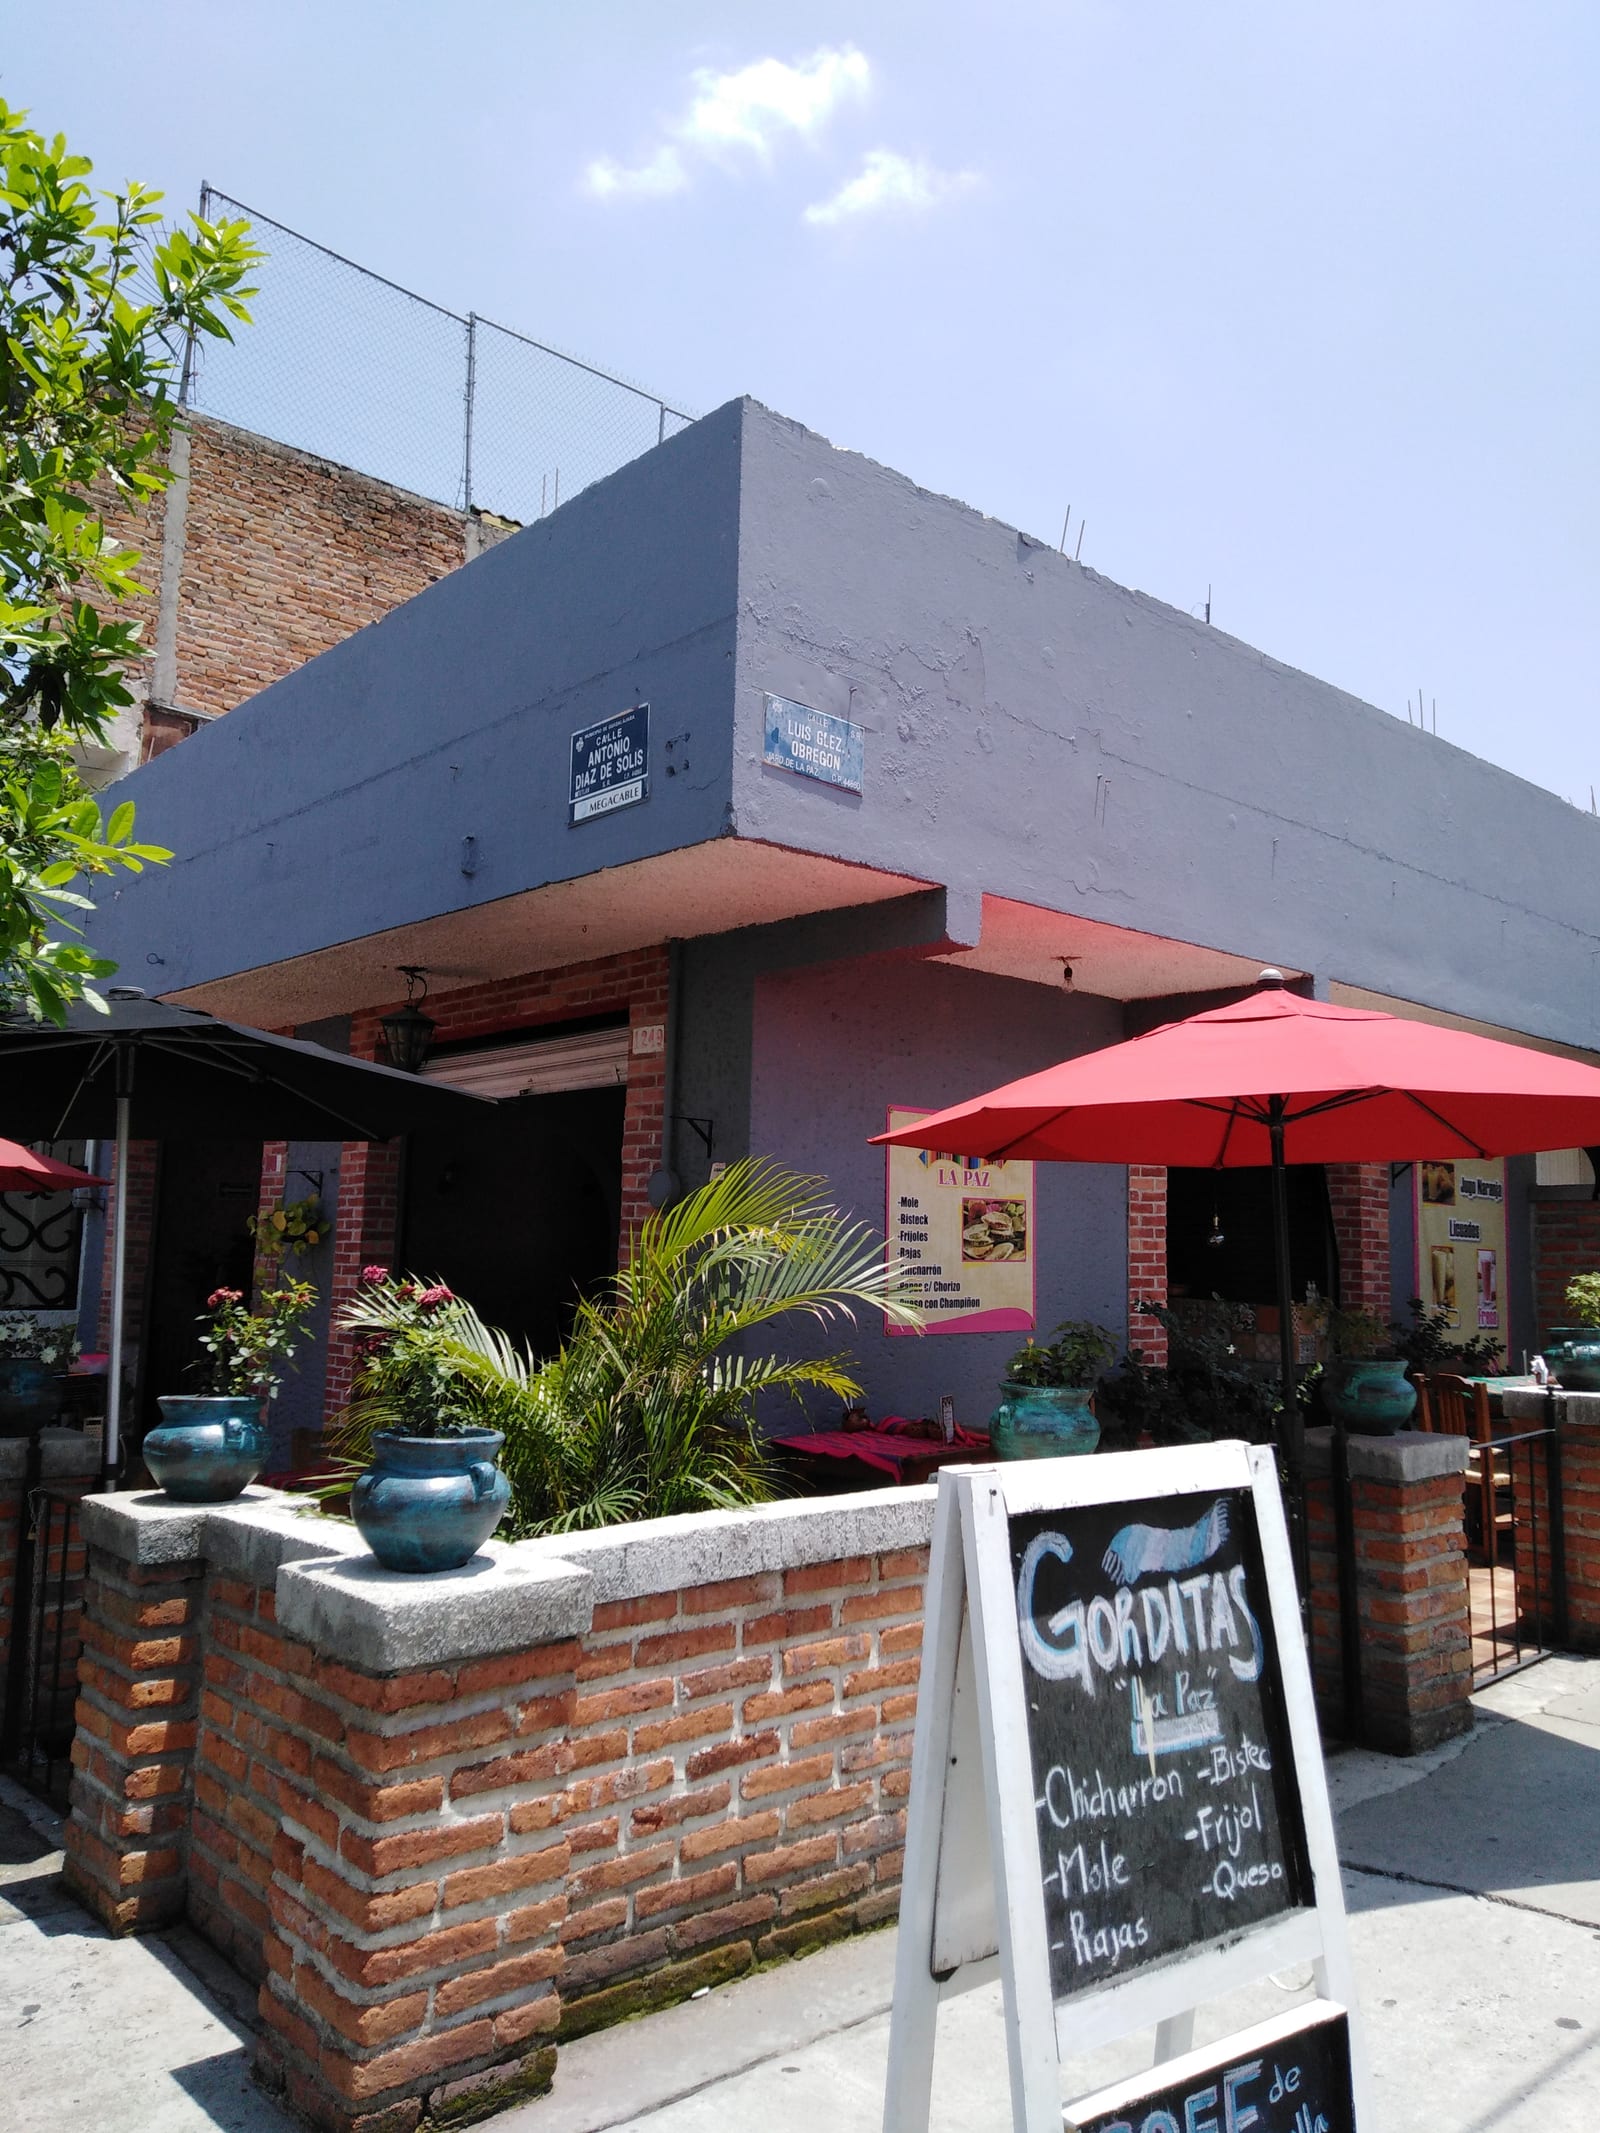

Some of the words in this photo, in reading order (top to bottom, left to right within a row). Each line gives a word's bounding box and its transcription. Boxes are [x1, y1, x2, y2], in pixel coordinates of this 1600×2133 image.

[807, 713, 829, 728] CALLE
[596, 728, 623, 746] CALLE
[788, 719, 811, 741] LUIS
[816, 730, 846, 754] GLEZ.
[588, 736, 630, 768] ANTONIO
[791, 740, 840, 771] OBREGON
[575, 768, 597, 791] DIAZ
[600, 761, 613, 780] DE
[616, 749, 644, 774] SOLIS
[785, 759, 794, 769] DE
[795, 761, 805, 772] LA
[806, 764, 820, 776] PAZ
[589, 786, 639, 813] MEGACABLE
[939, 1169, 957, 1185] LA
[963, 1170, 990, 1187] PAZ
[1450, 1219, 1480, 1239] Licuados
[933, 1280, 961, 1292] Chorizo
[924, 1299, 938, 1309] con
[1018, 1530, 1264, 1700] GORDITAS
[1268, 2062, 1301, 2104] de
